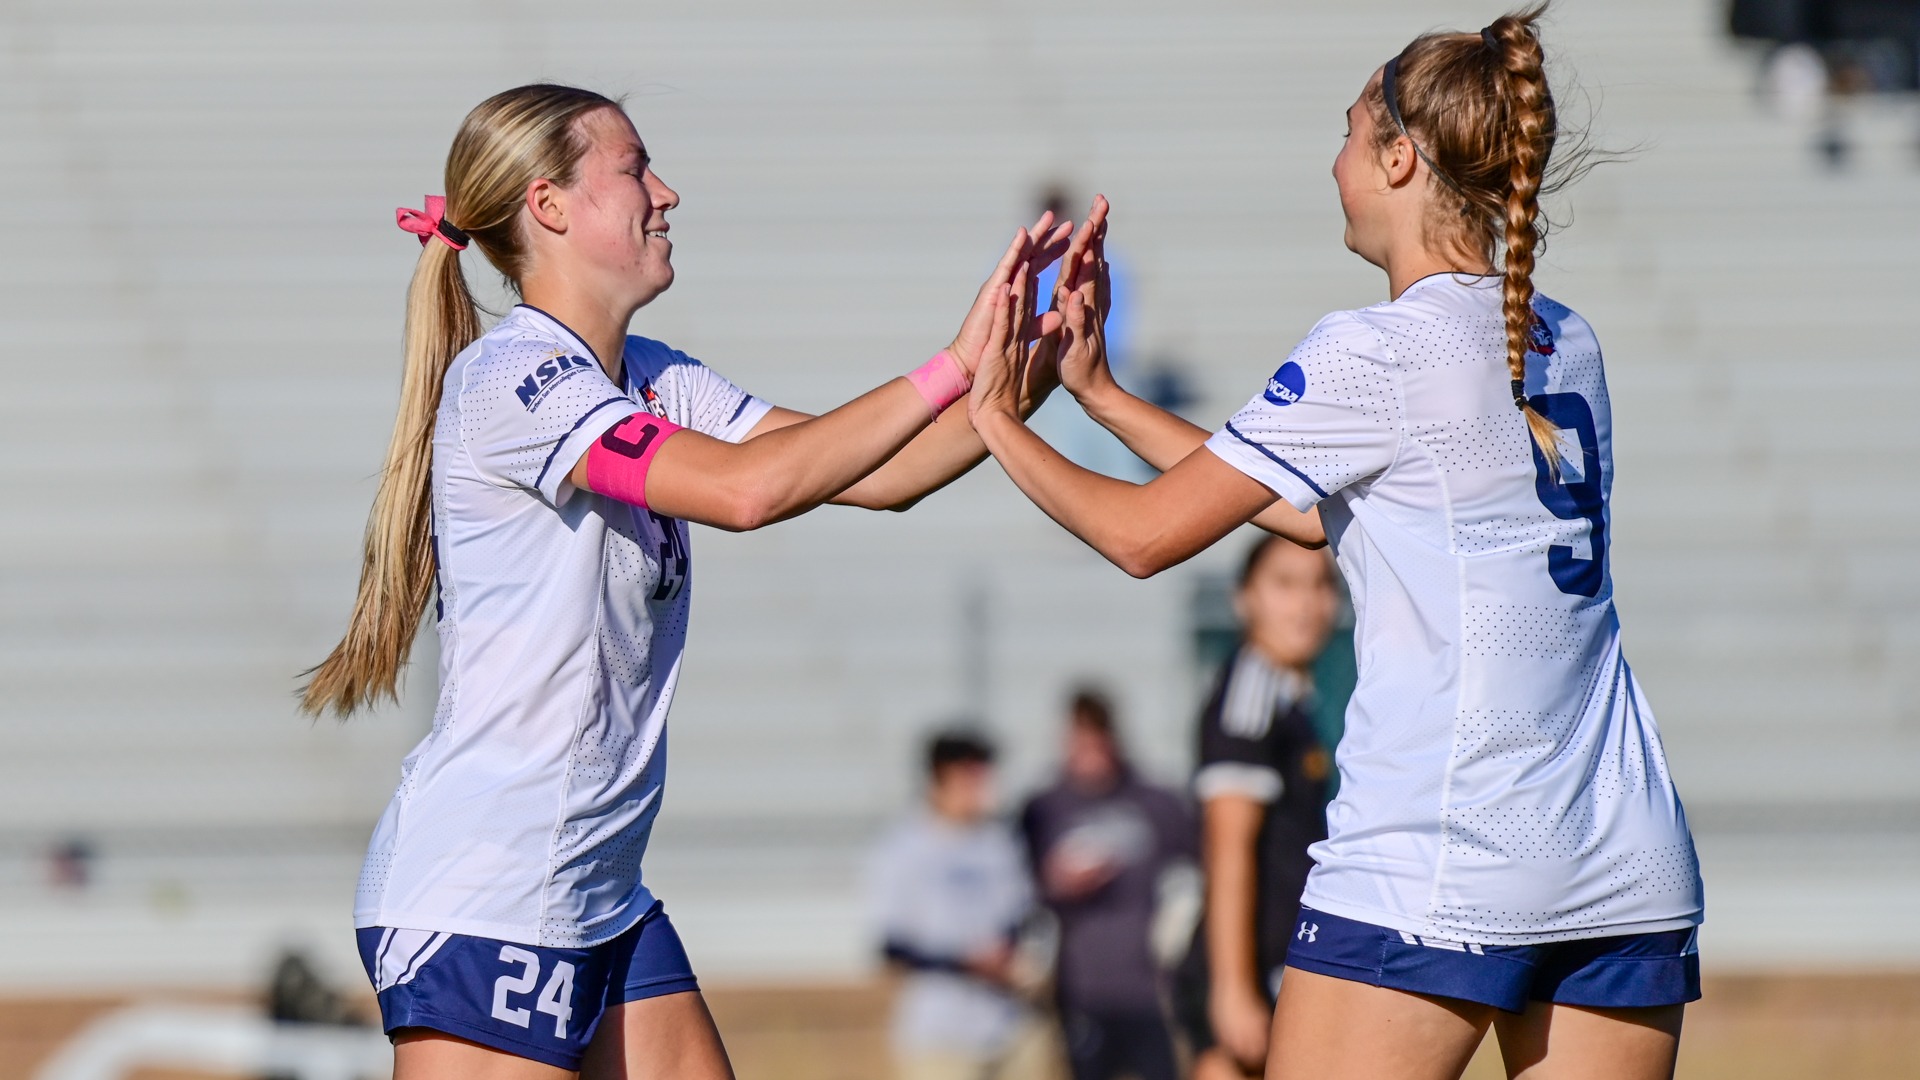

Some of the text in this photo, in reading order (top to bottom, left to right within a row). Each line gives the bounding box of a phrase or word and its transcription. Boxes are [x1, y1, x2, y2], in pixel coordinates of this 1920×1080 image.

[515, 355, 593, 407] NSIC
[1267, 377, 1299, 402] NCAA
[601, 415, 660, 460] C
[1528, 391, 1605, 598] 9
[491, 944, 576, 1040] 24
